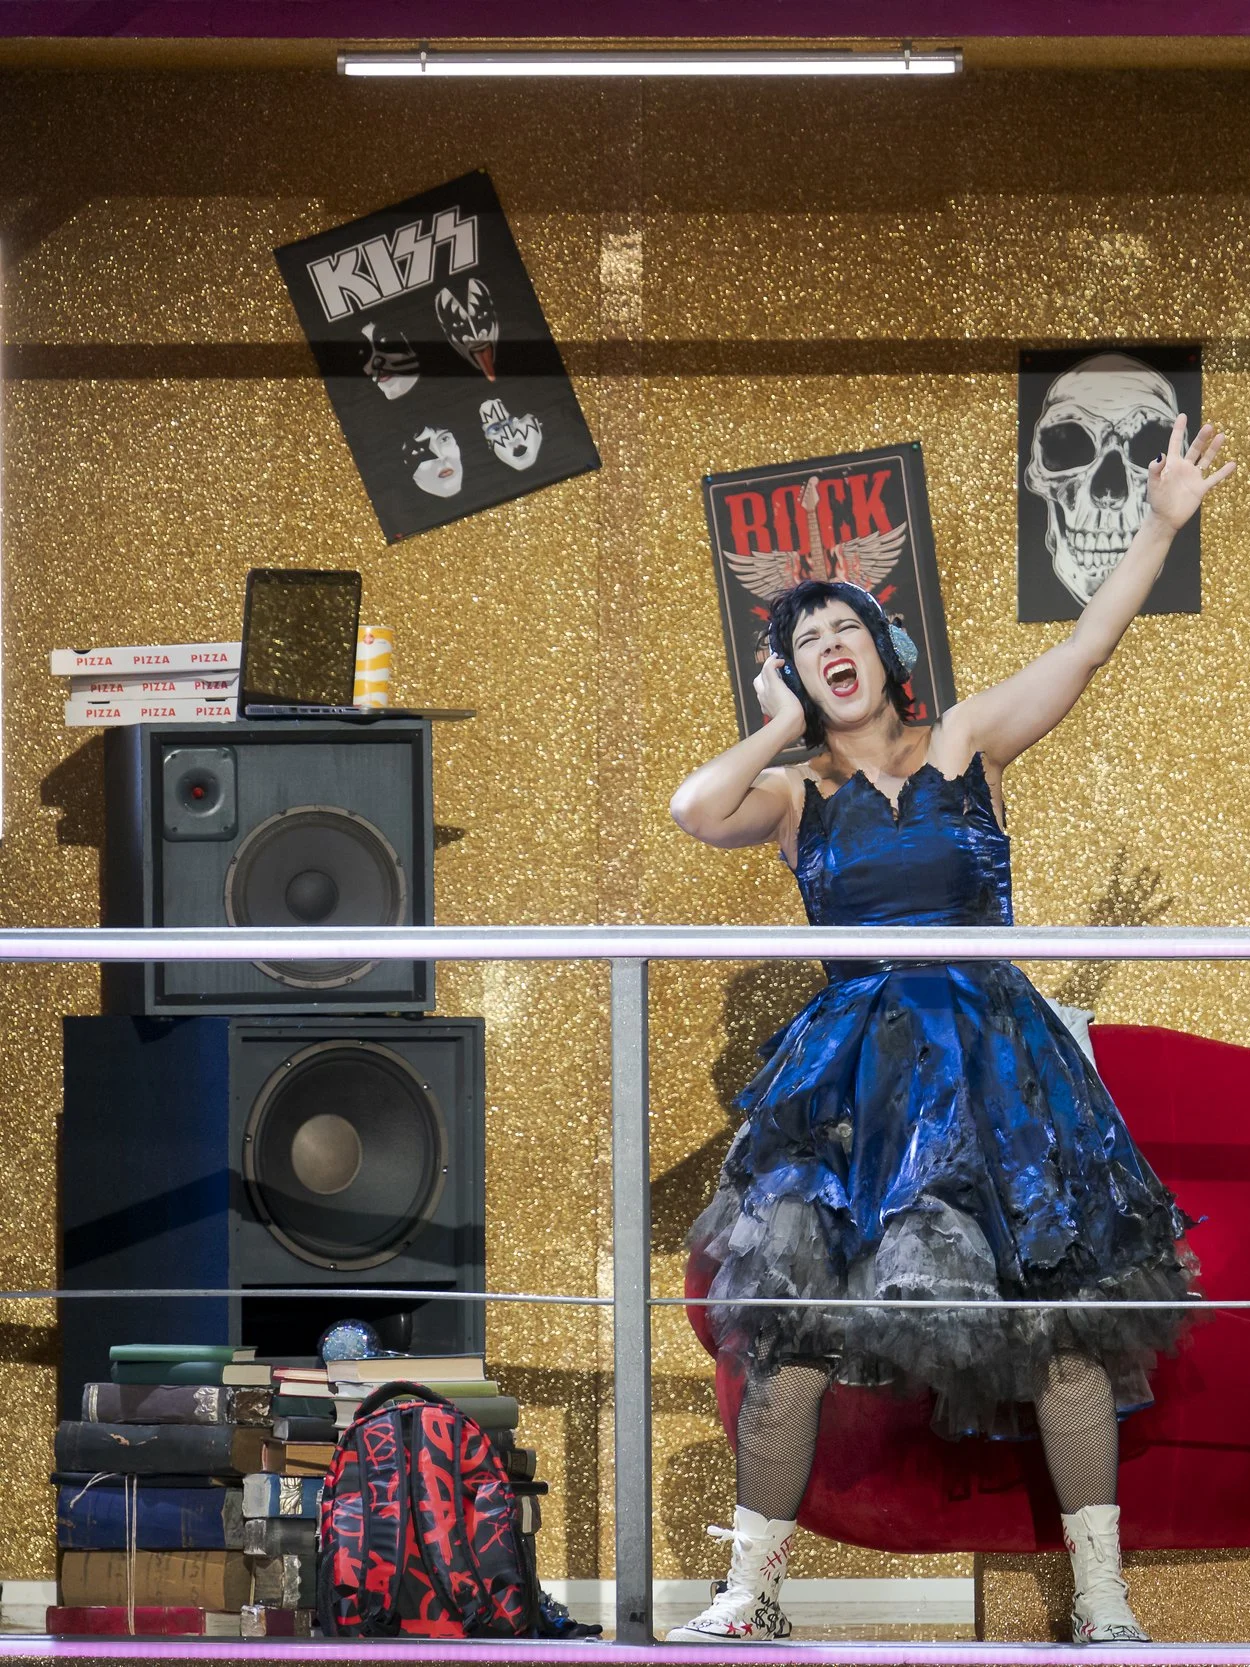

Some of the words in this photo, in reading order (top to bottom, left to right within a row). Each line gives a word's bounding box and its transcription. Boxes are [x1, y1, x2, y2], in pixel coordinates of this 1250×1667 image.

[307, 205, 477, 323] KISS
[725, 470, 892, 556] ROCK
[76, 657, 112, 666] PIZZA
[133, 655, 170, 664] PIZZA
[191, 653, 228, 662] PIZZA
[90, 683, 124, 692] PIZZA
[142, 682, 176, 691] PIZZA
[195, 680, 228, 690] PIZZA
[86, 708, 121, 718] PIZZA
[141, 708, 176, 717] PIZZA
[196, 706, 231, 717] PIZZA
